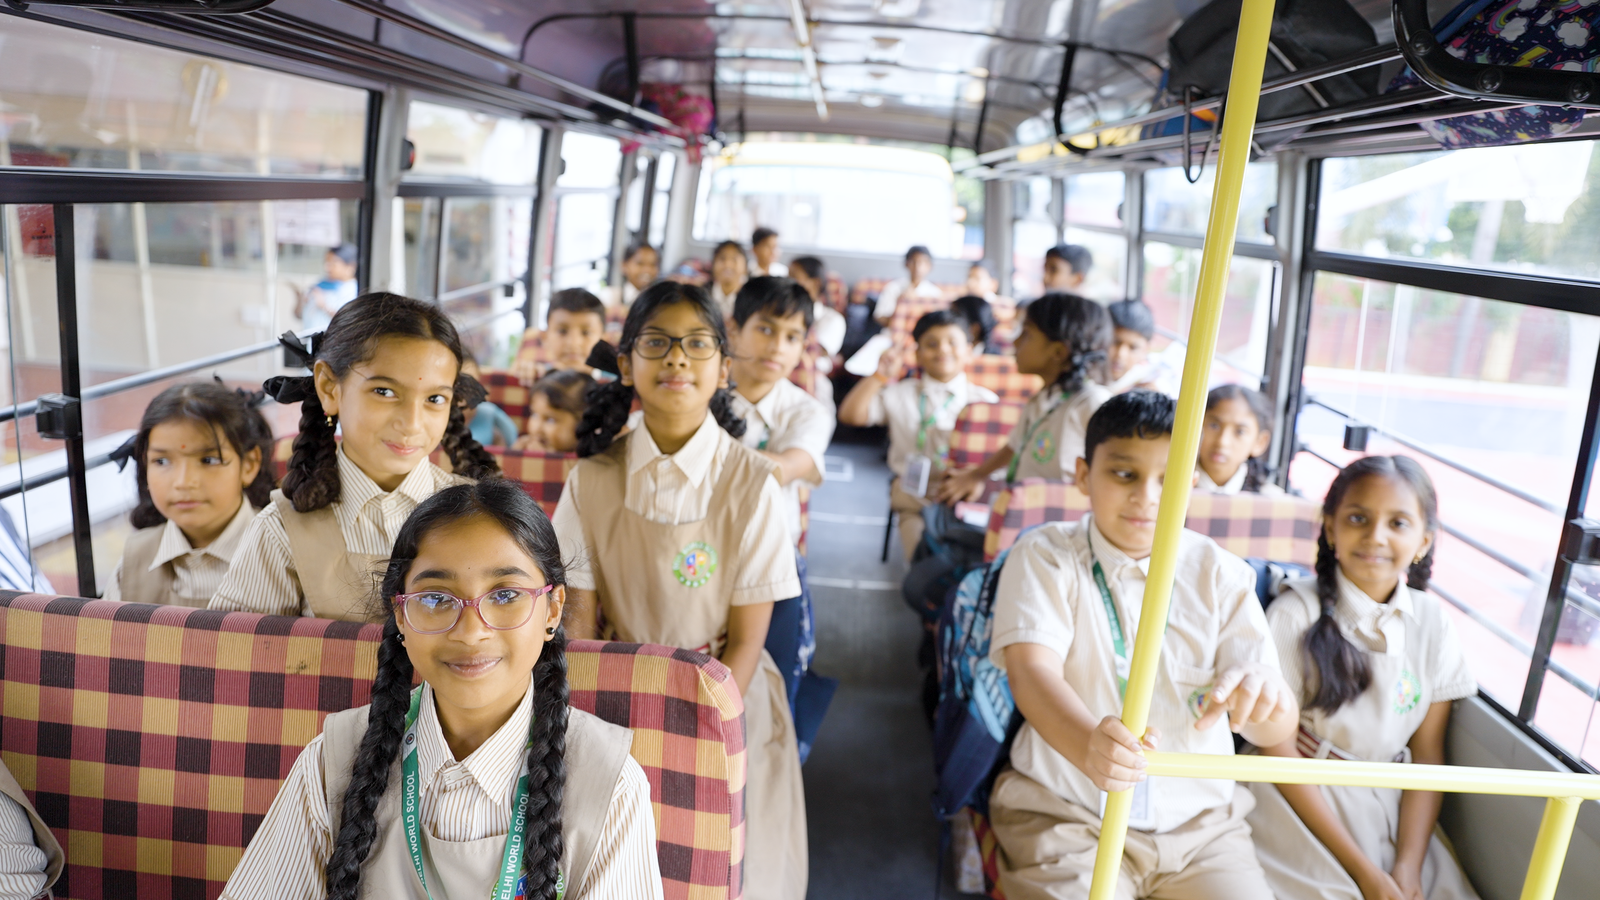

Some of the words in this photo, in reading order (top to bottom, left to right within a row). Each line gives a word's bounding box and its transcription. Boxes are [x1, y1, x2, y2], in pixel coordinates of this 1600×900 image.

[406, 770, 415, 813] SCHOOL
[514, 792, 530, 833] SCHOOL
[406, 814, 419, 854] WORLD
[505, 834, 522, 874] WORLD
[501, 875, 514, 900] ELHI
